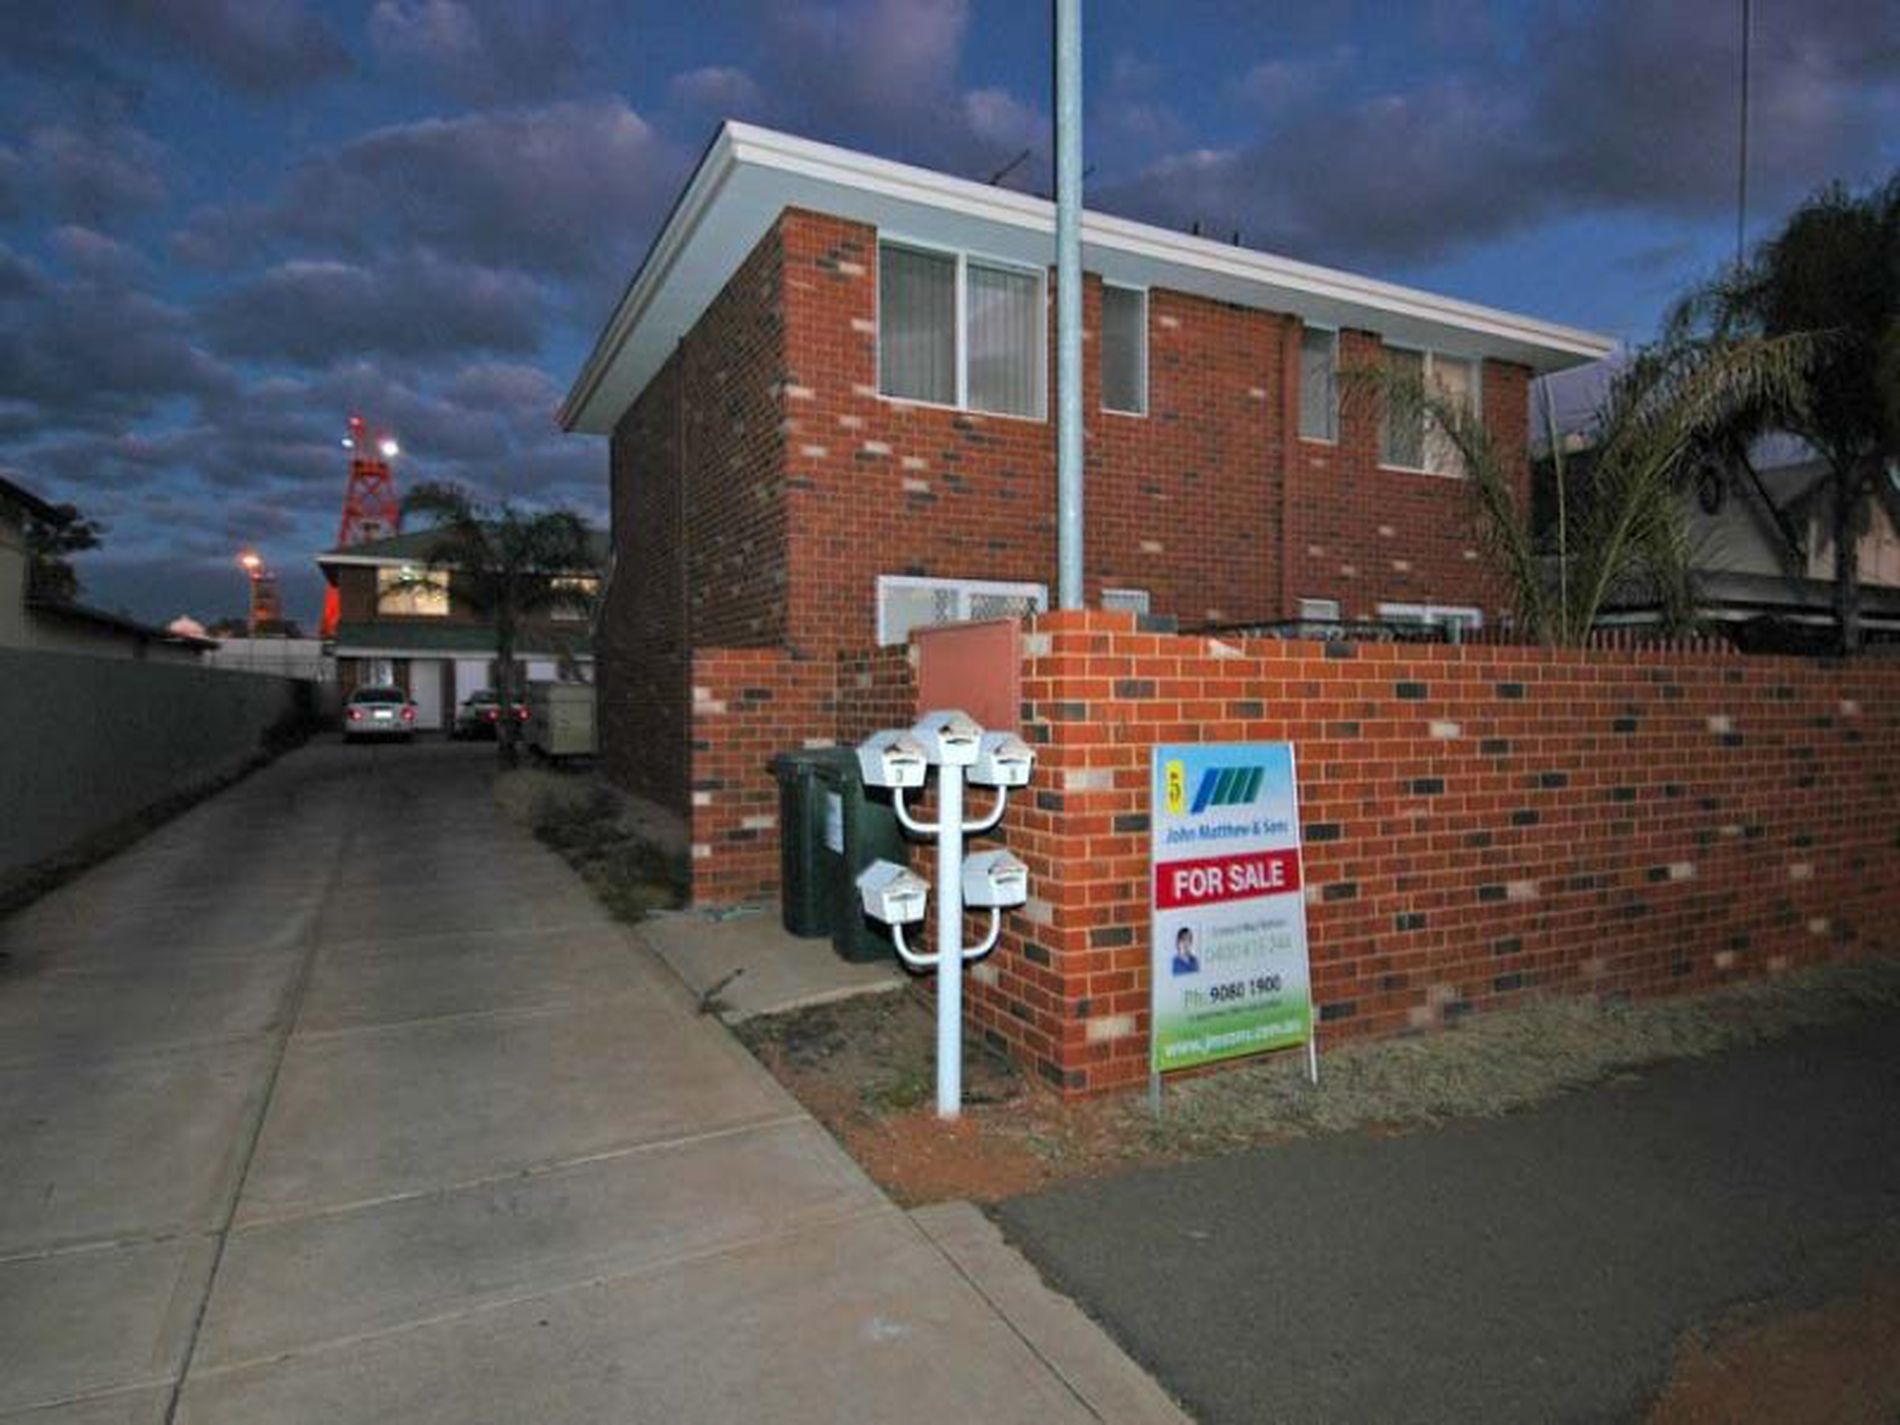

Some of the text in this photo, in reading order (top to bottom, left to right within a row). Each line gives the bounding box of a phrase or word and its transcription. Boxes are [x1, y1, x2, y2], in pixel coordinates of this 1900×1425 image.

[1166, 827, 1197, 844] John
[1200, 822, 1249, 840] Matthew
[1252, 821, 1261, 836] &
[1173, 859, 1285, 900] FOR SALE
